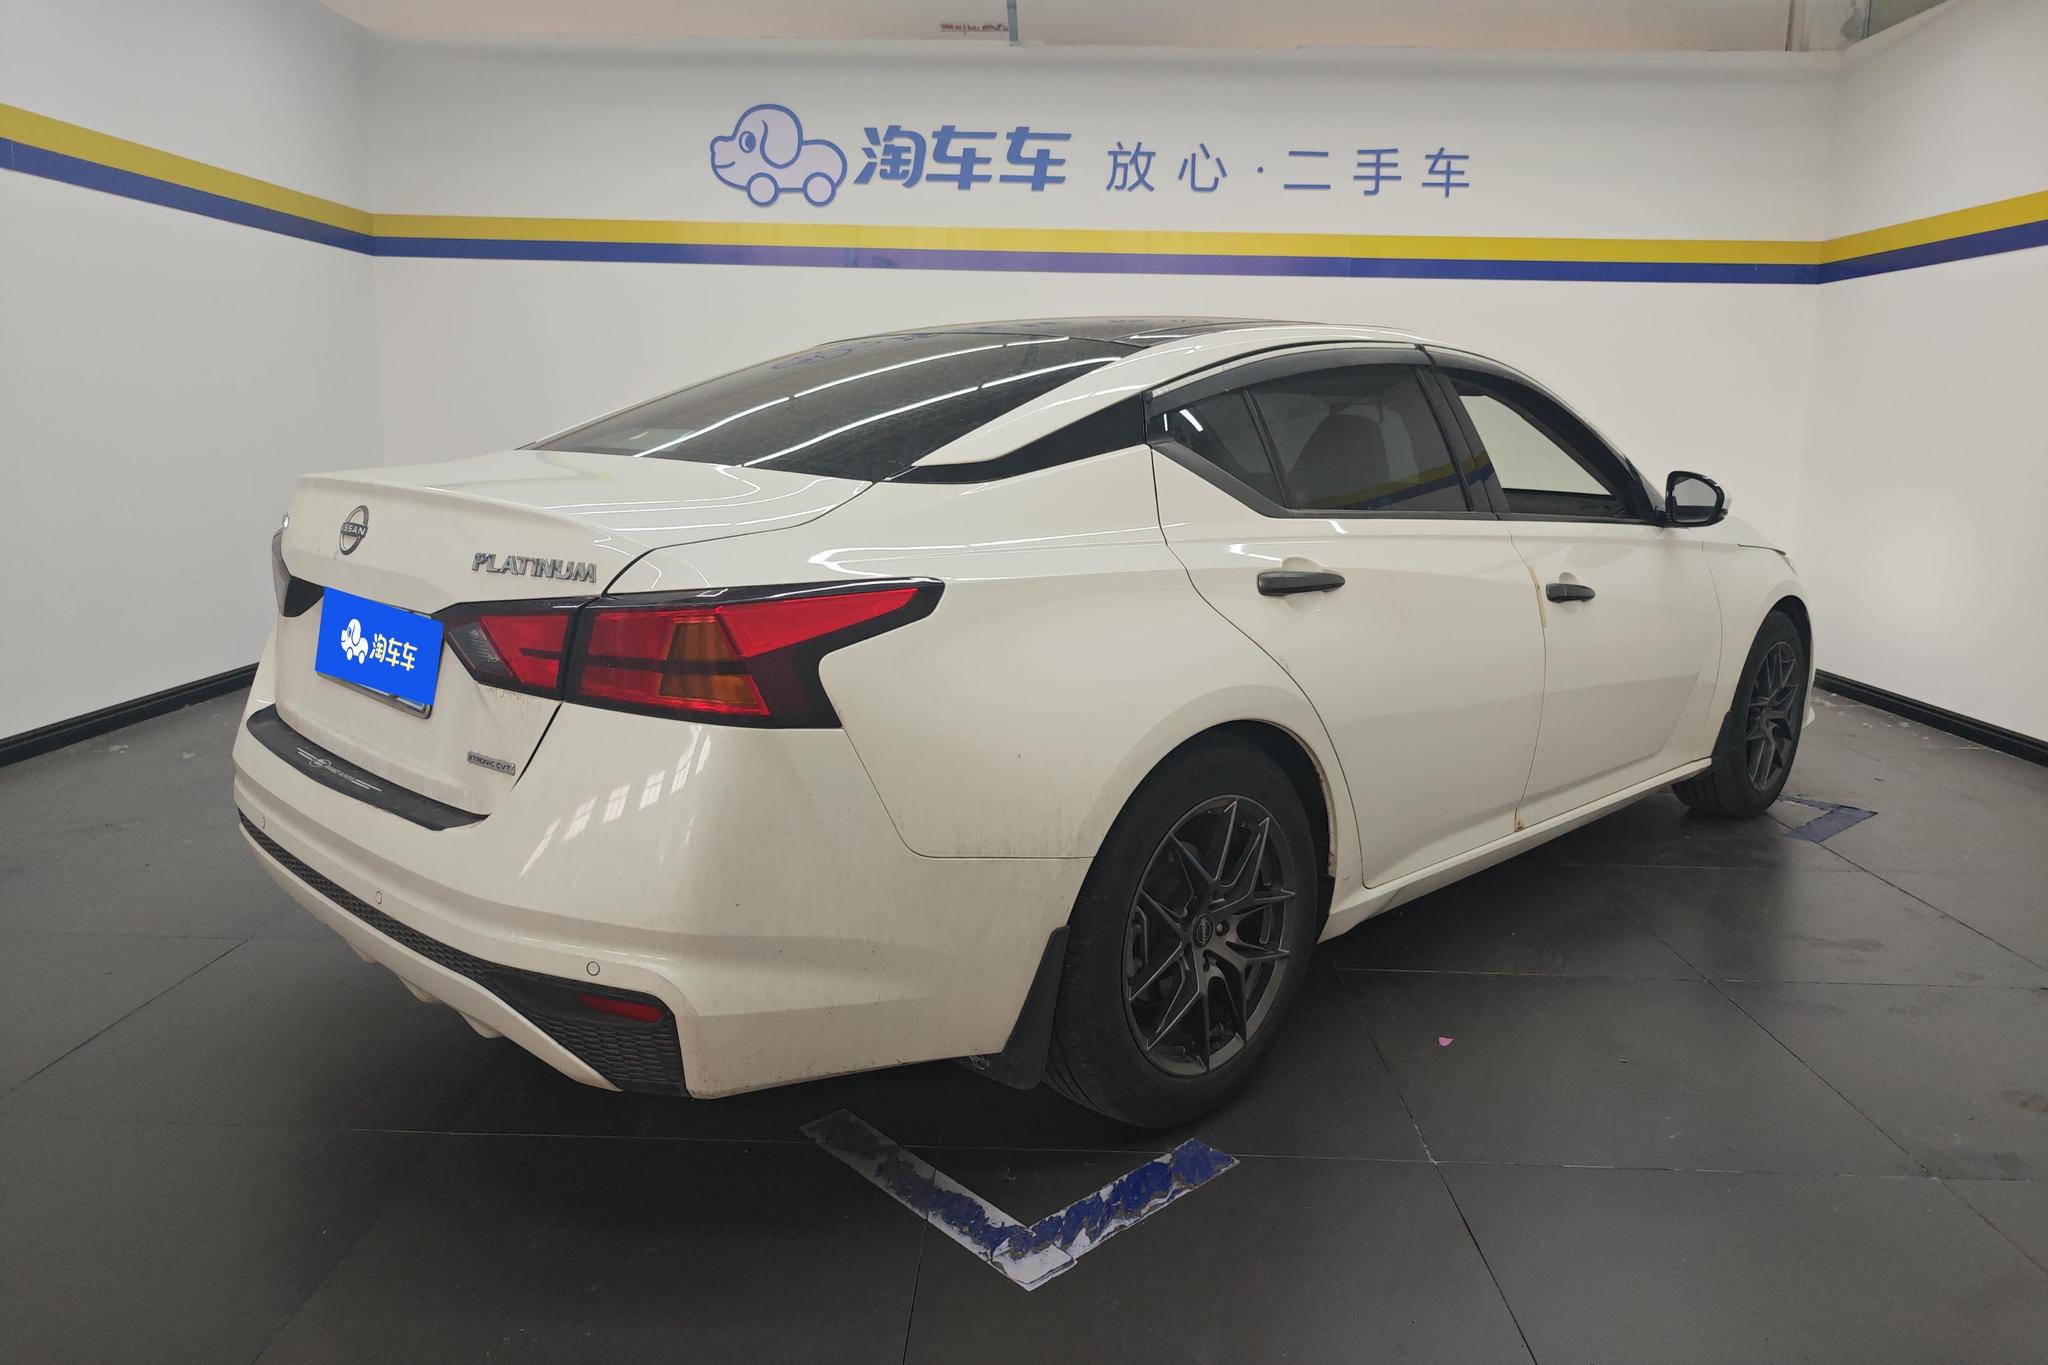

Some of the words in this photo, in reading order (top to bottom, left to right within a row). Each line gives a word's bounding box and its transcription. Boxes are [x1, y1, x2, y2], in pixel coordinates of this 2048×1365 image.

[853, 125, 1072, 191] 淘车车
[471, 552, 597, 583] PLATINUM
